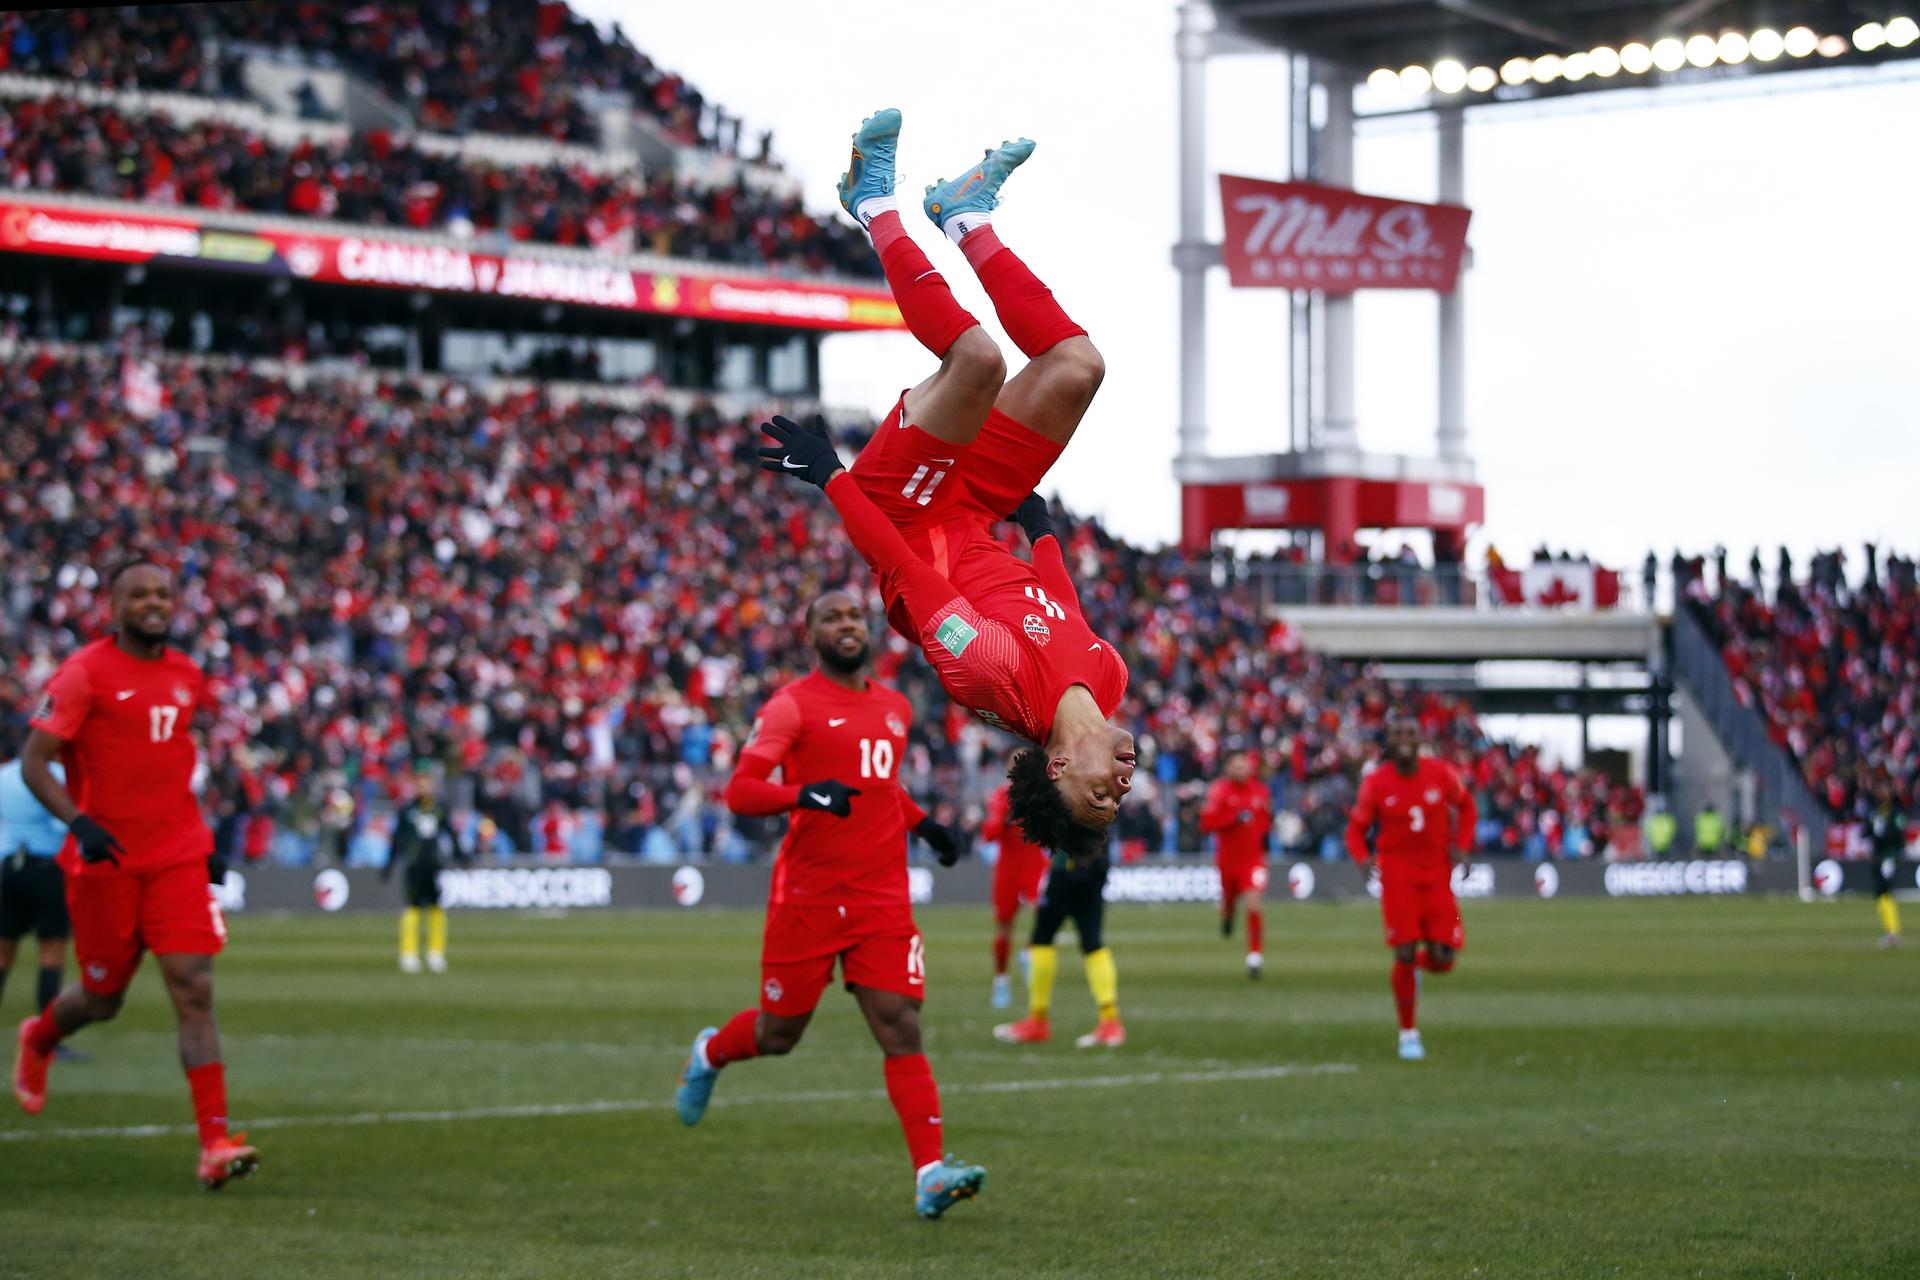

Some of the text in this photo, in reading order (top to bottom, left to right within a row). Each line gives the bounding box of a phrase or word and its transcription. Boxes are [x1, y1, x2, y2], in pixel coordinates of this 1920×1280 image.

[1233, 194, 1444, 260] Mill St.
[337, 238, 476, 291] CANADA
[498, 257, 637, 306] JAMAICA
[901, 464, 946, 506] 11
[1024, 586, 1066, 620] 11
[150, 705, 178, 742] 17
[859, 738, 894, 779] 10
[1408, 805, 1425, 832] 3
[1101, 866, 1223, 902] NESOCCE
[1604, 860, 1748, 897] ONESOCCER
